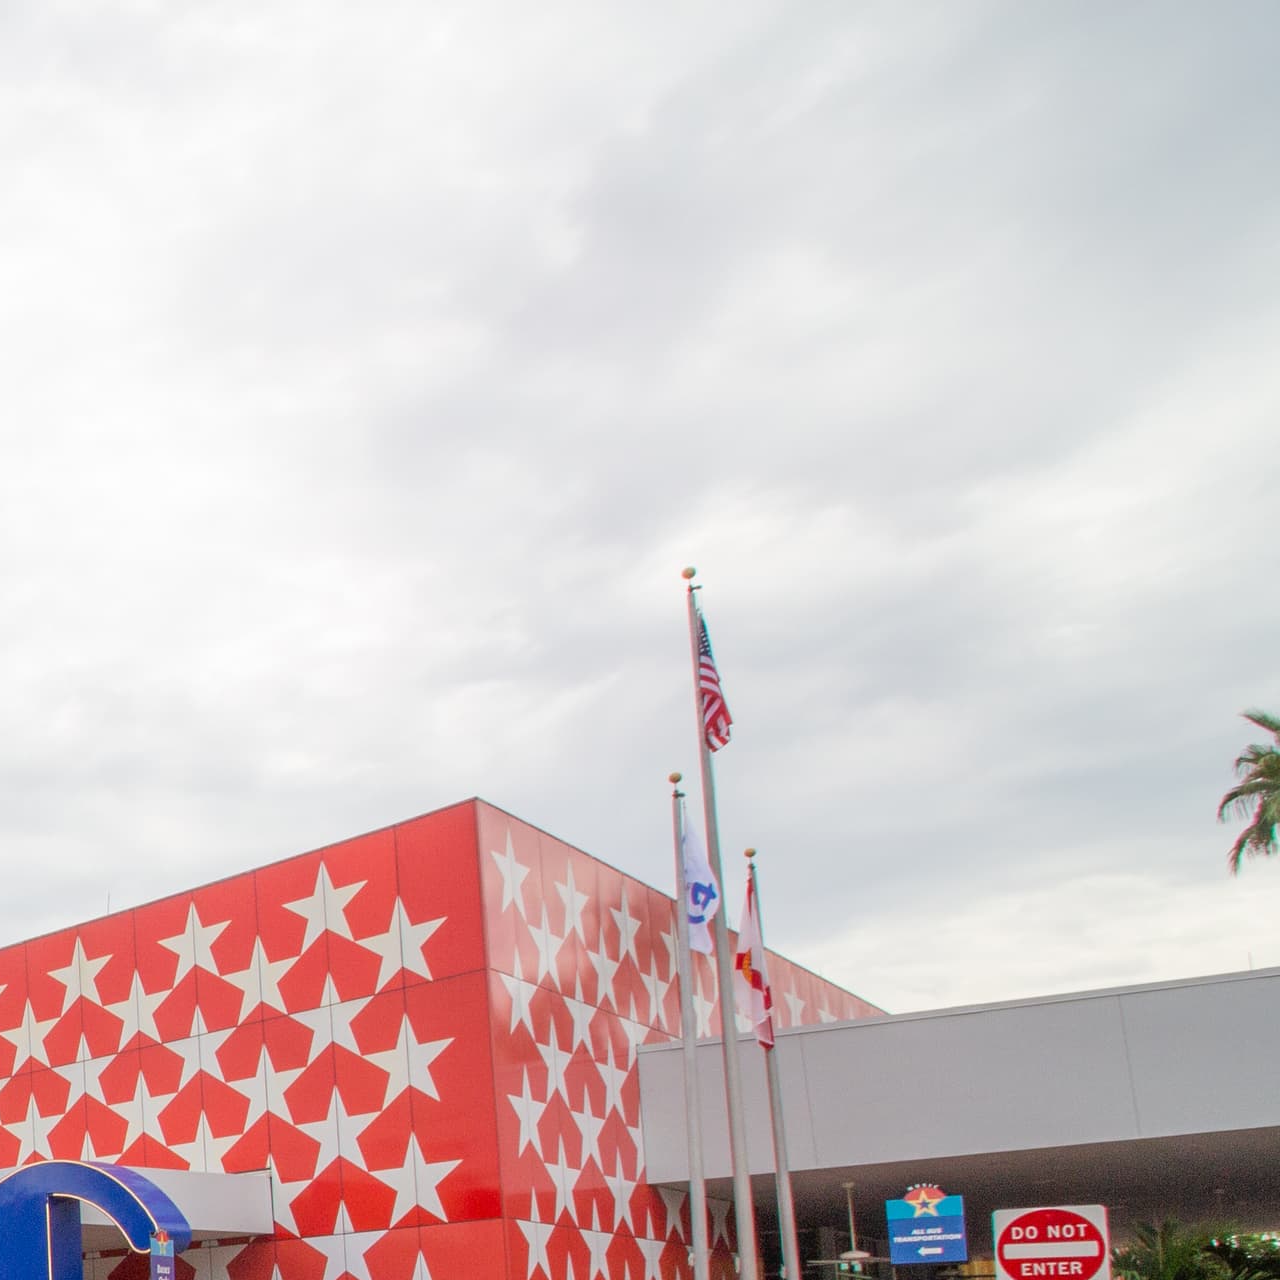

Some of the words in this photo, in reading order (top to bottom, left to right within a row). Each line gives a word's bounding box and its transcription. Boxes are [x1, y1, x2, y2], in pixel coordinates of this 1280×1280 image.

[893, 1233, 962, 1243] TRANSPORTATION
[1011, 1226, 1038, 1240] DO
[1047, 1224, 1088, 1239] NOT
[1021, 1261, 1083, 1276] ENTER
